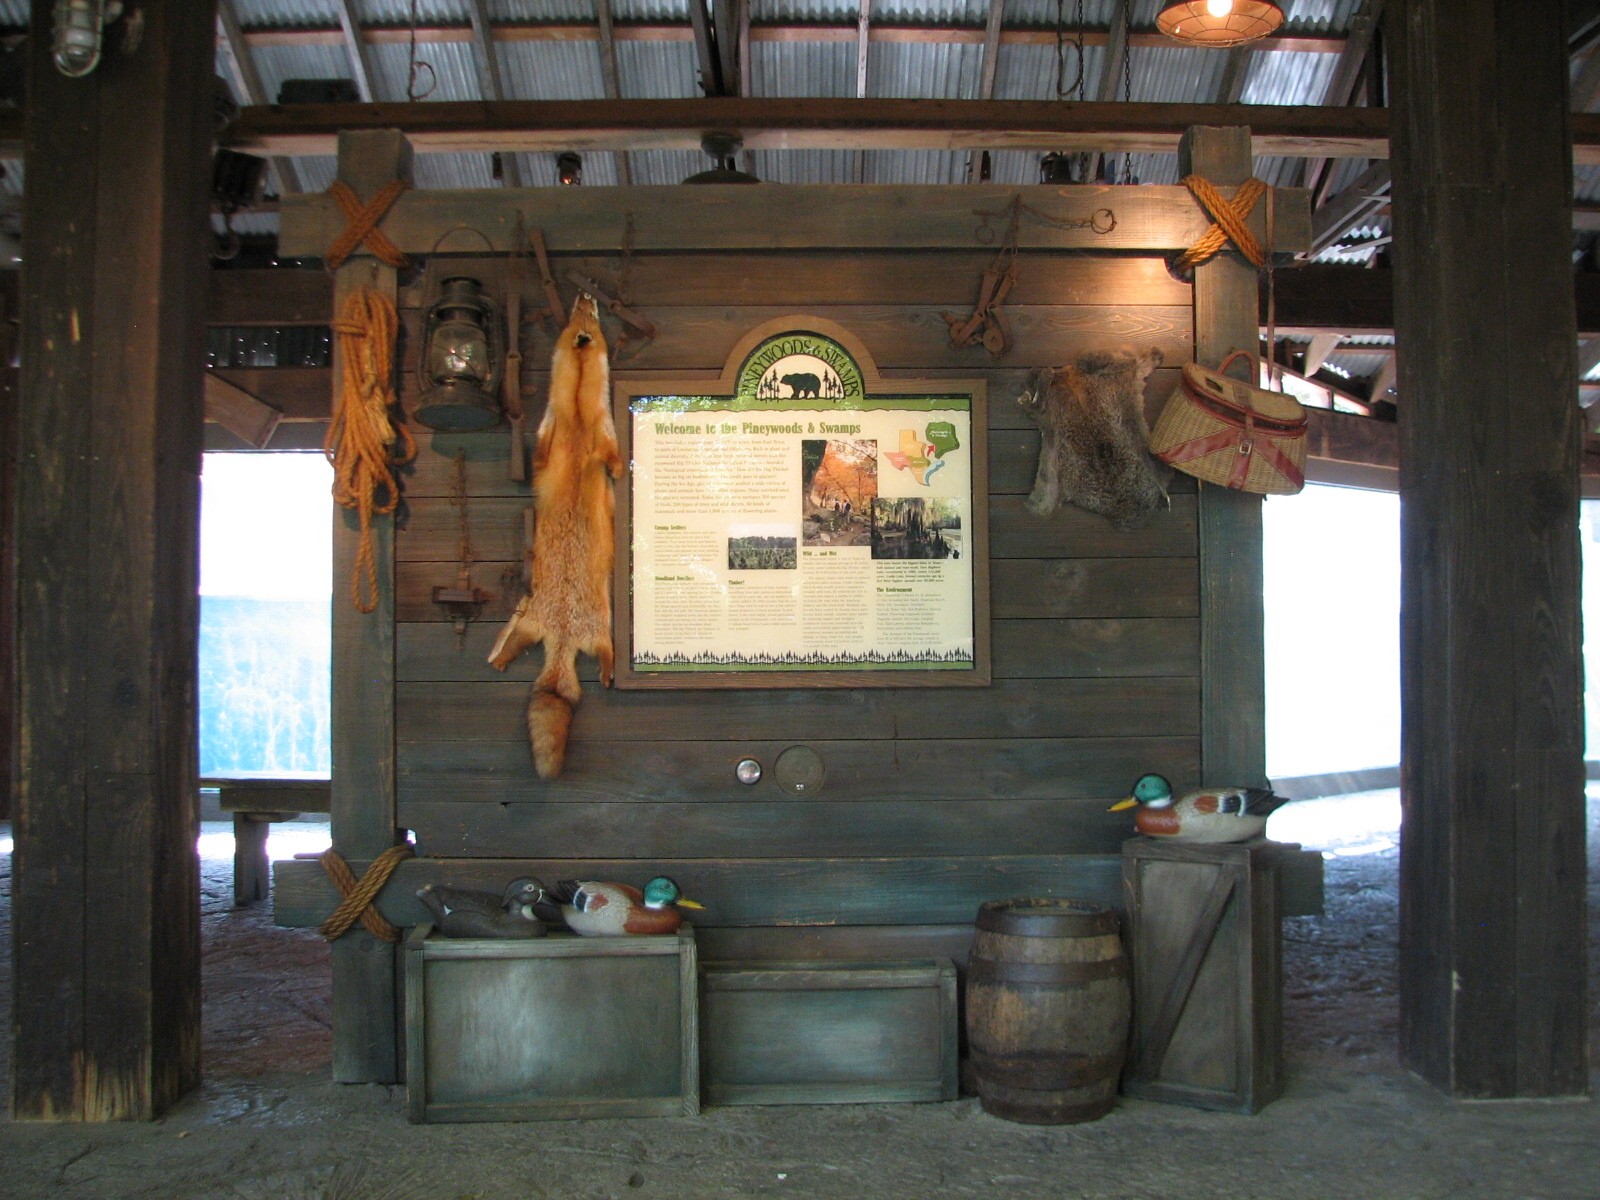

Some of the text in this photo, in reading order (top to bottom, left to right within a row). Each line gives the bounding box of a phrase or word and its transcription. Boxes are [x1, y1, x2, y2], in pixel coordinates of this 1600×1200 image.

[812, 345, 821, 357] &
[821, 345, 860, 397] SWAMPS
[655, 422, 701, 435] Welcome
[721, 422, 737, 434] the
[742, 422, 803, 436] Pineywoods
[807, 423, 816, 434] &
[819, 421, 861, 435] Swamps
